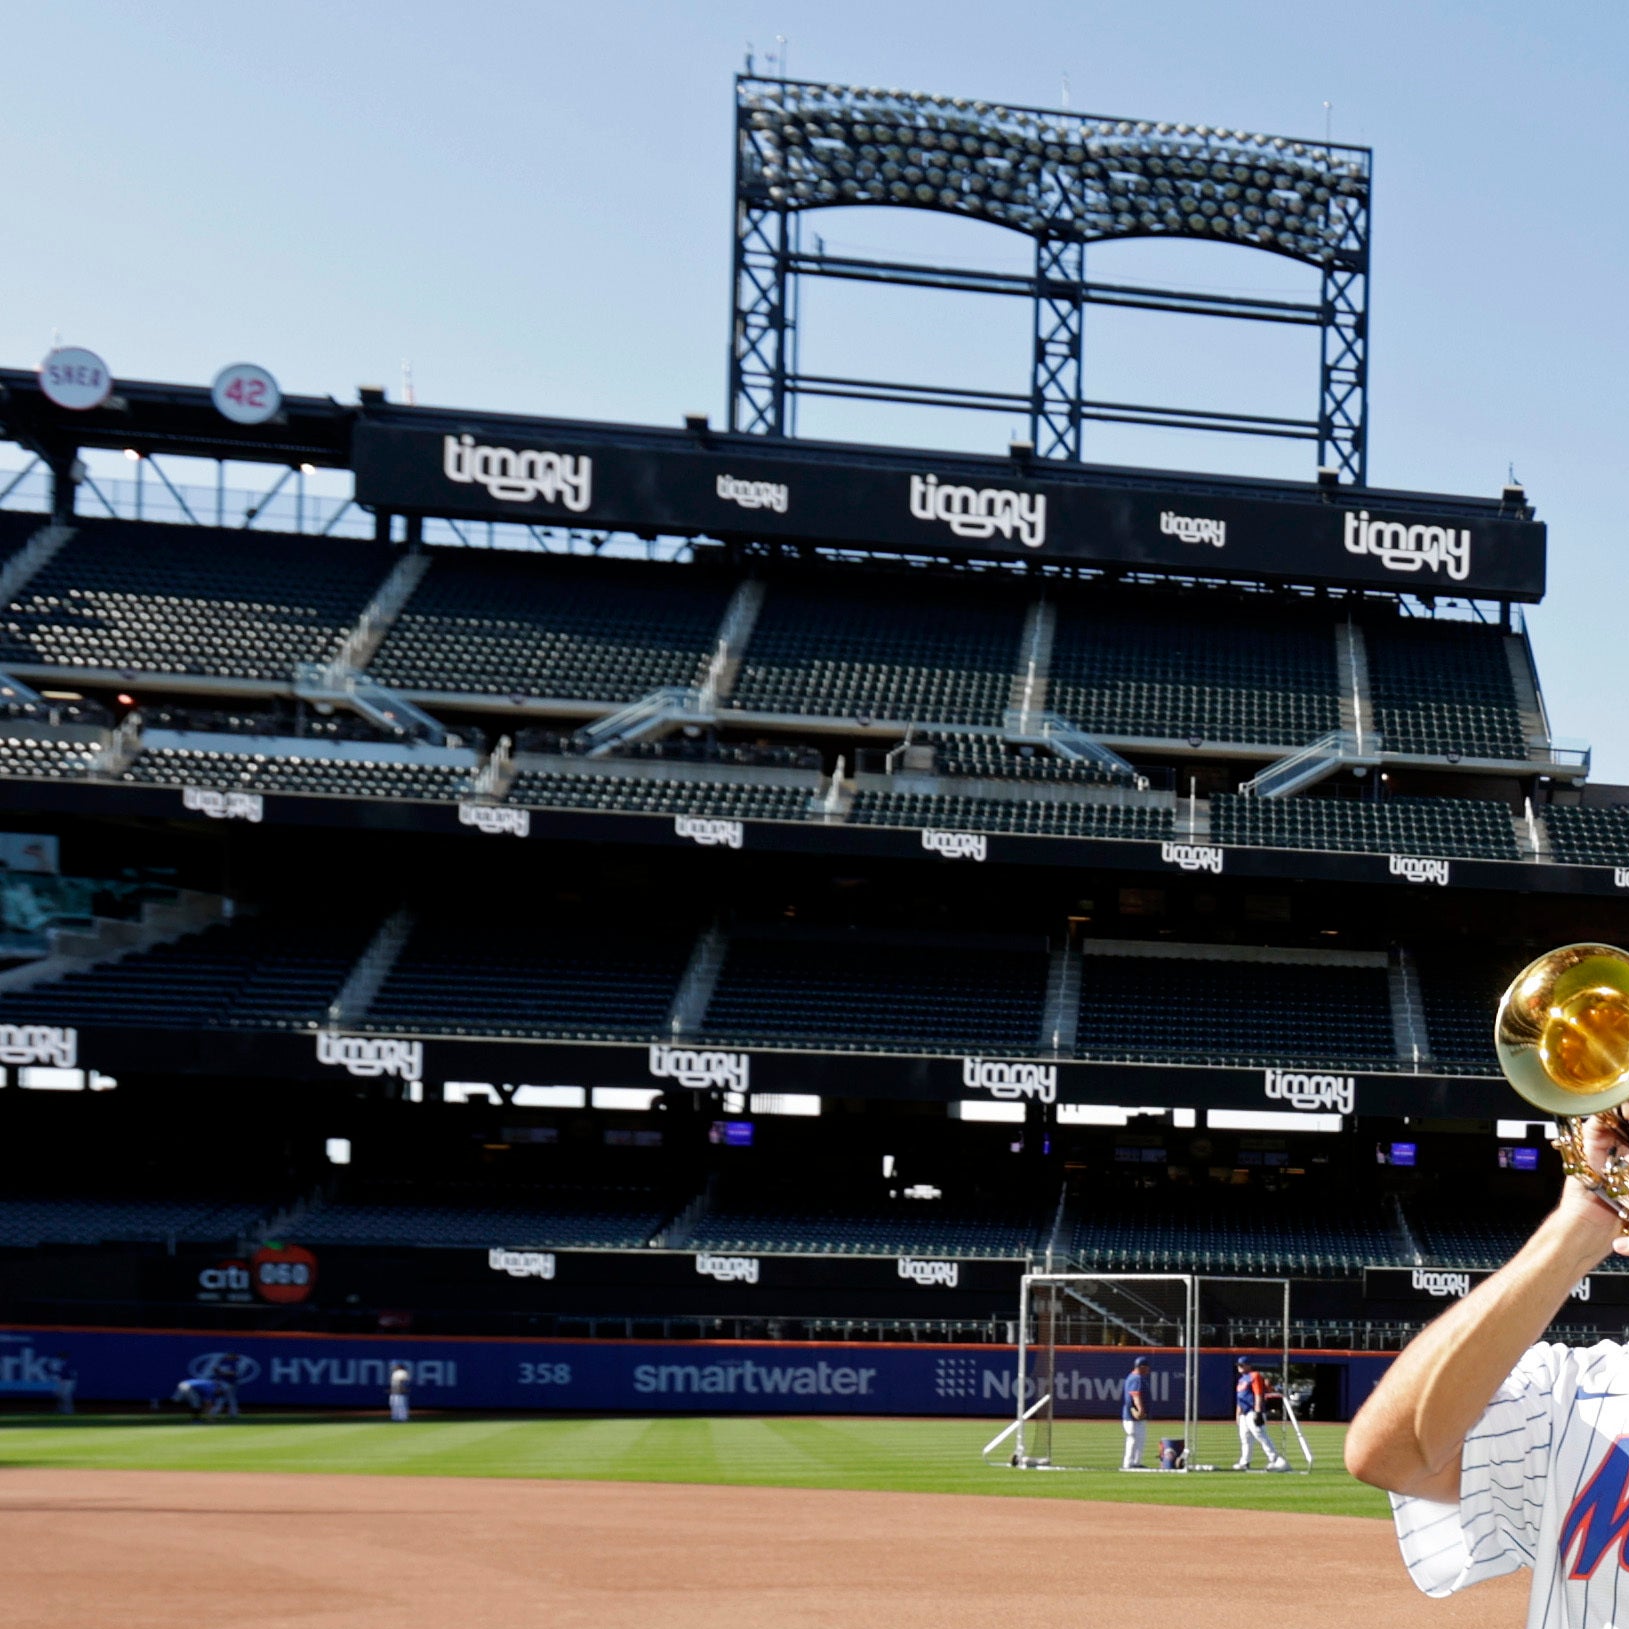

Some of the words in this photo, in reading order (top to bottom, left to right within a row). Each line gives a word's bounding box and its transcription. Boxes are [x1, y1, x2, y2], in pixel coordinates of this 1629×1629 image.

[224, 378, 266, 407] 42
[444, 434, 592, 511] timmy
[910, 474, 1046, 548] timmy
[1345, 511, 1470, 580] timmy
[518, 1362, 570, 1385] 358
[633, 1360, 875, 1395] smartwater
[983, 1370, 1169, 1401] Northwll
